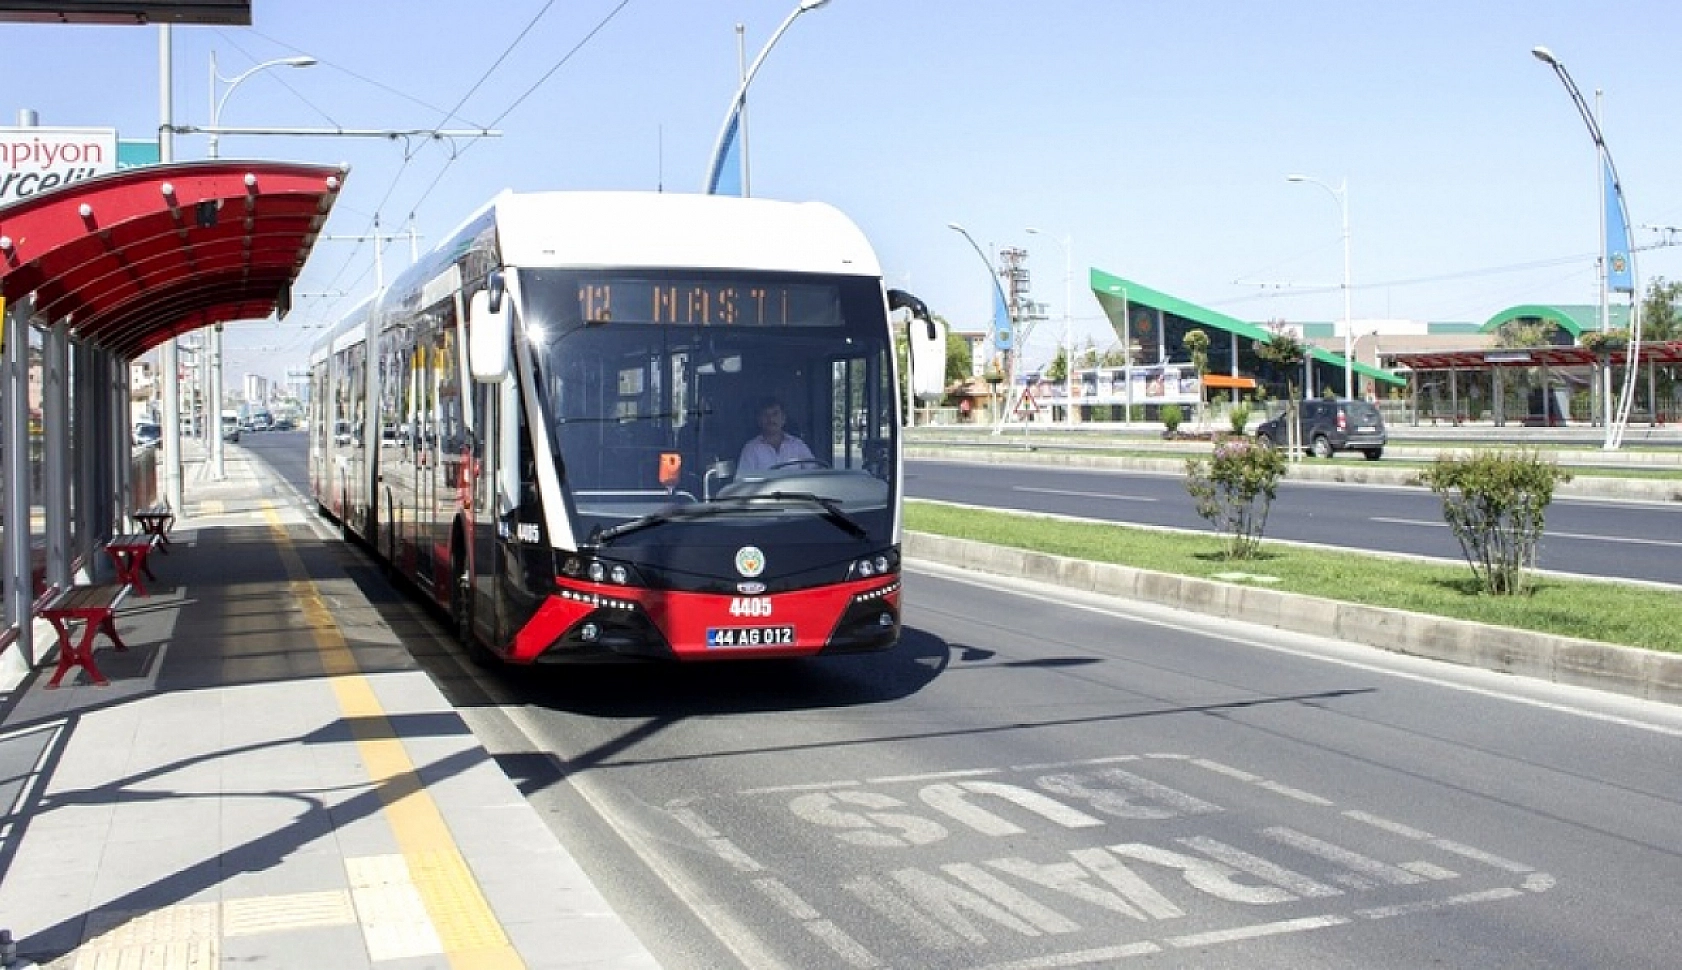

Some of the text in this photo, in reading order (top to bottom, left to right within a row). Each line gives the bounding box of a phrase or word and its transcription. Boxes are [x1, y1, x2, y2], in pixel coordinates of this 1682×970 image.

[729, 597, 773, 617] 4405
[715, 628, 792, 645] 44 AG 012
[790, 768, 1227, 846] BUS
